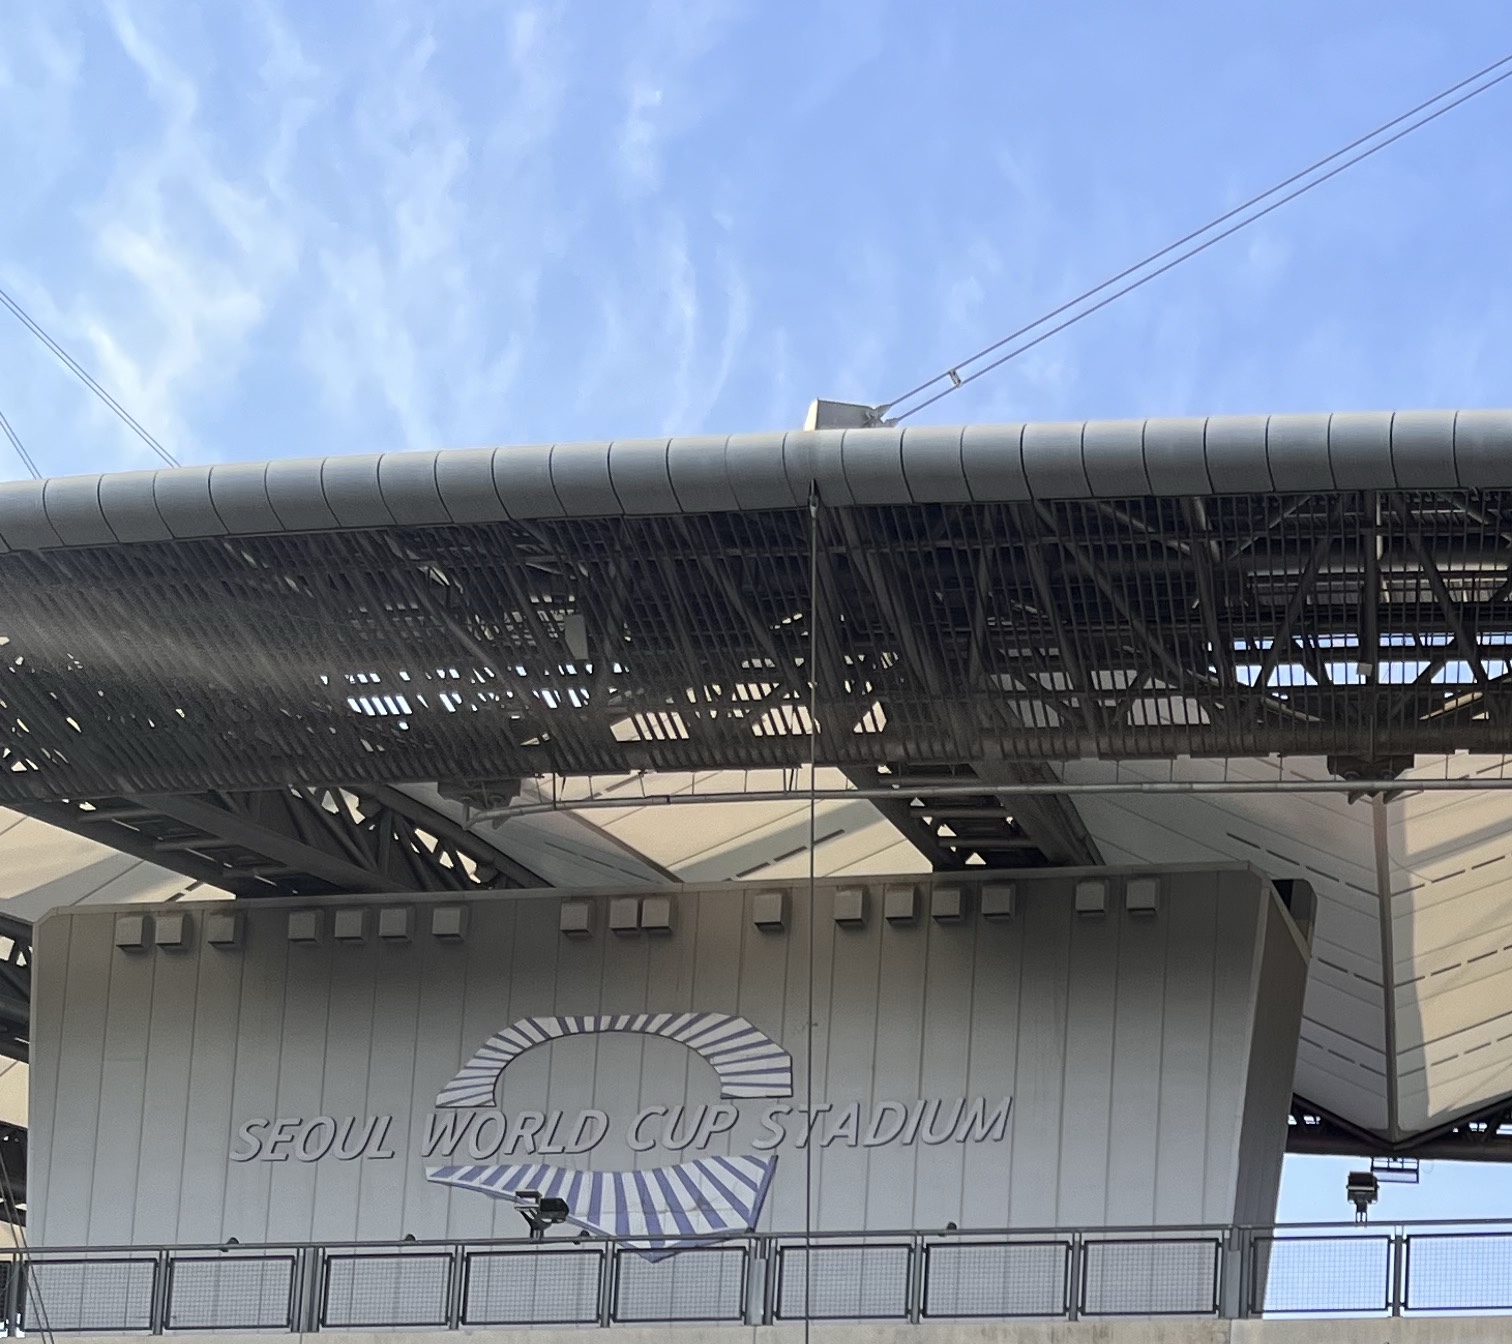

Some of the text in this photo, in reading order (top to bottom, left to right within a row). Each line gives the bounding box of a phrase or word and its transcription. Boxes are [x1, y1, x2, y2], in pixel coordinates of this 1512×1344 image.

[229, 1095, 1014, 1163] SEOUL WORLD CUP STADIUM
